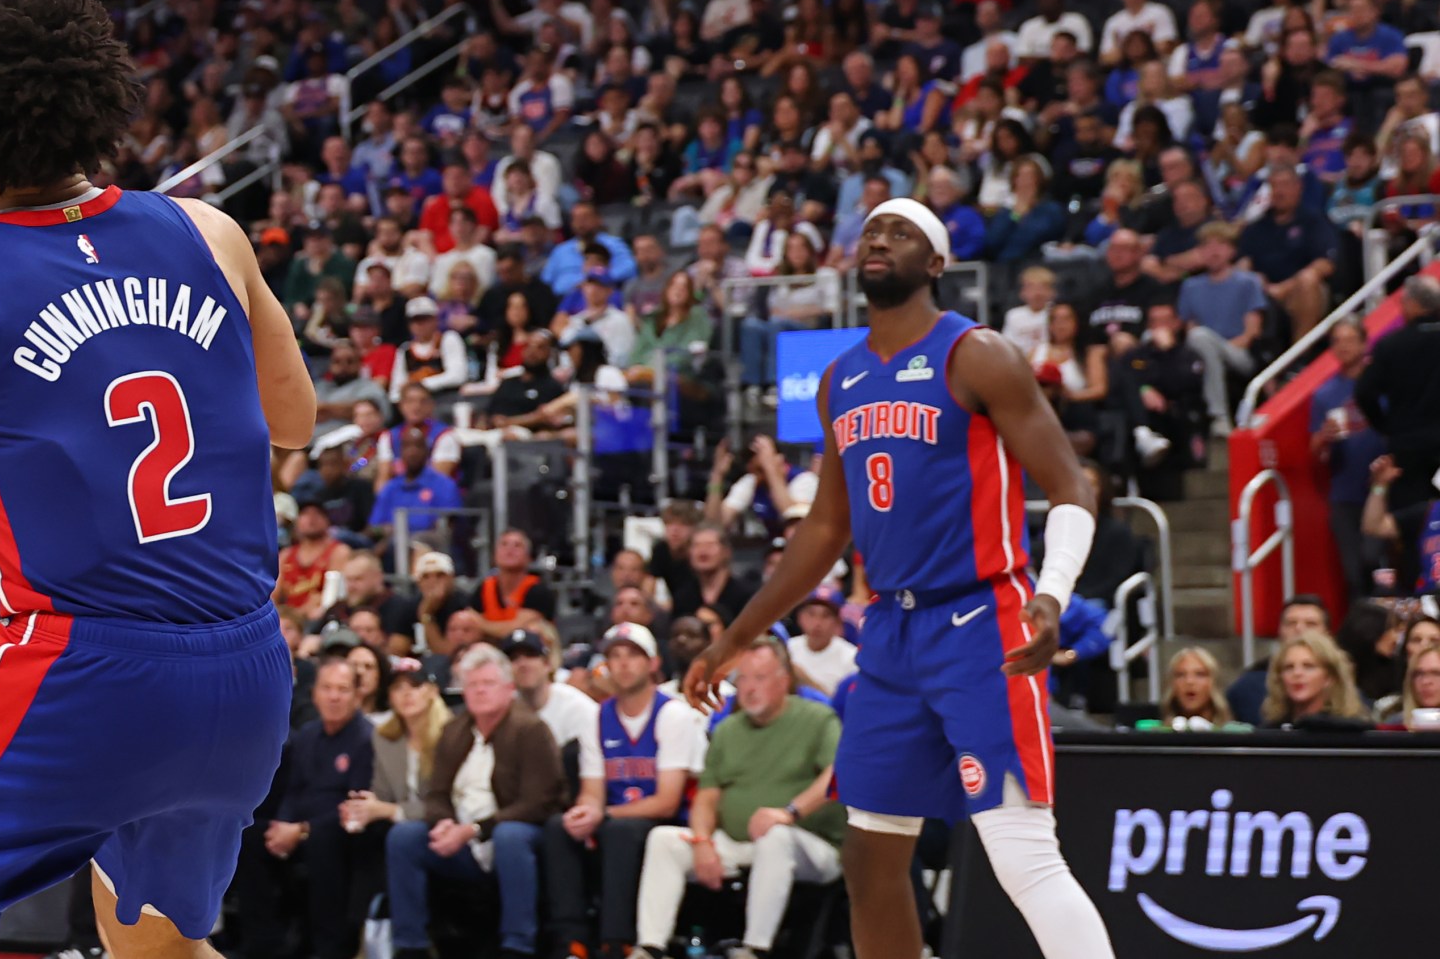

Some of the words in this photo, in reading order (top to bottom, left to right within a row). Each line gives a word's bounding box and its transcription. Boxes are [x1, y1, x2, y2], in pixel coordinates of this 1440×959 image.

[13, 277, 227, 383] CUNNINGHAM
[104, 370, 212, 545] 2
[832, 401, 943, 456] DETROIT
[866, 452, 894, 513] 8
[1108, 789, 1371, 892] prime
